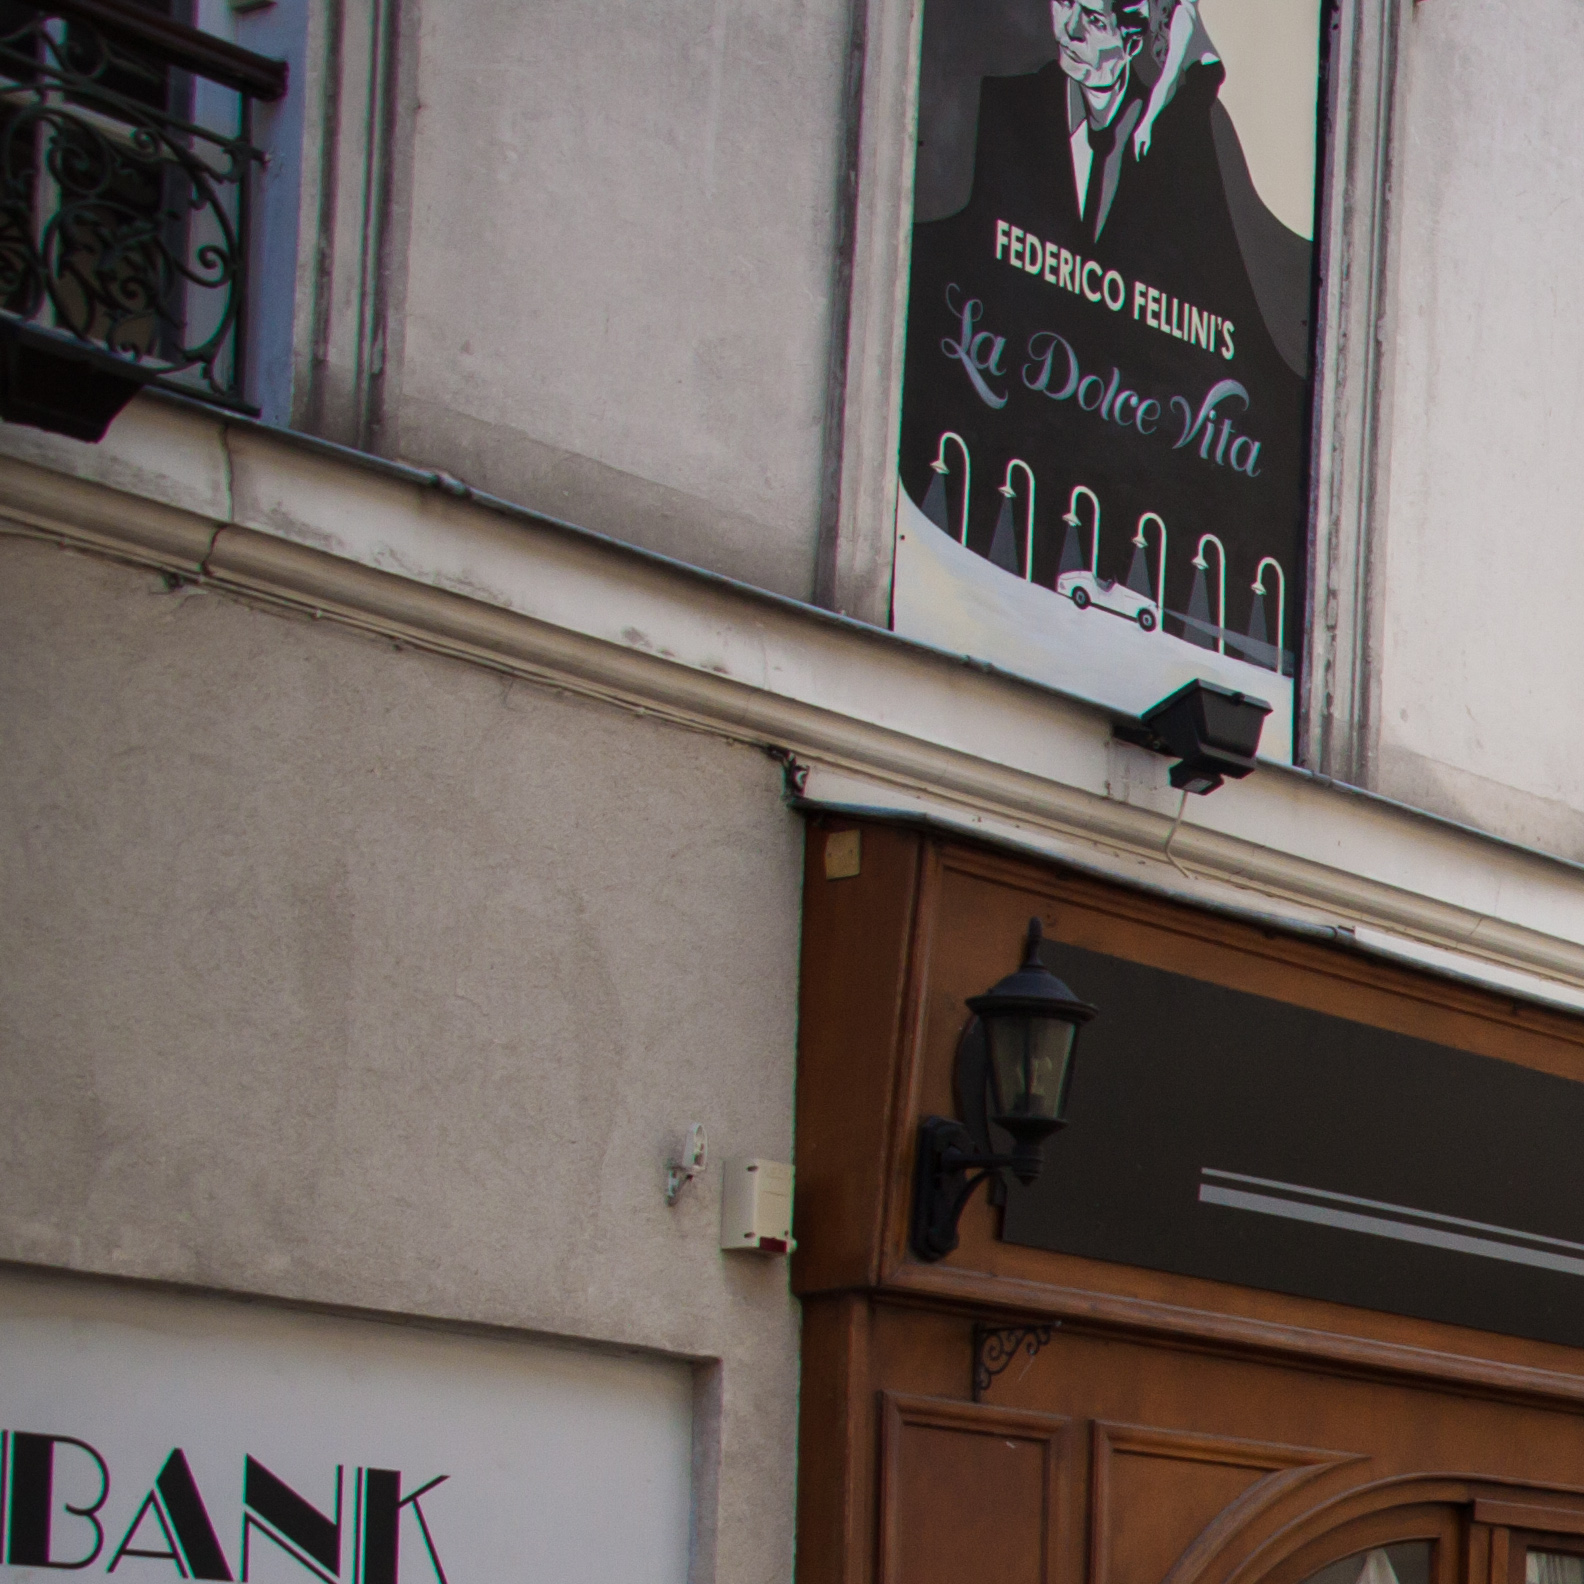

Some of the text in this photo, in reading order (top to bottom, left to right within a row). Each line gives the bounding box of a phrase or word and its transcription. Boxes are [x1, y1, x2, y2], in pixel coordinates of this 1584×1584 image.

[995, 219, 1236, 361] FEDERICO FELLINI'S
[941, 283, 1262, 479] La Dolce Vita
